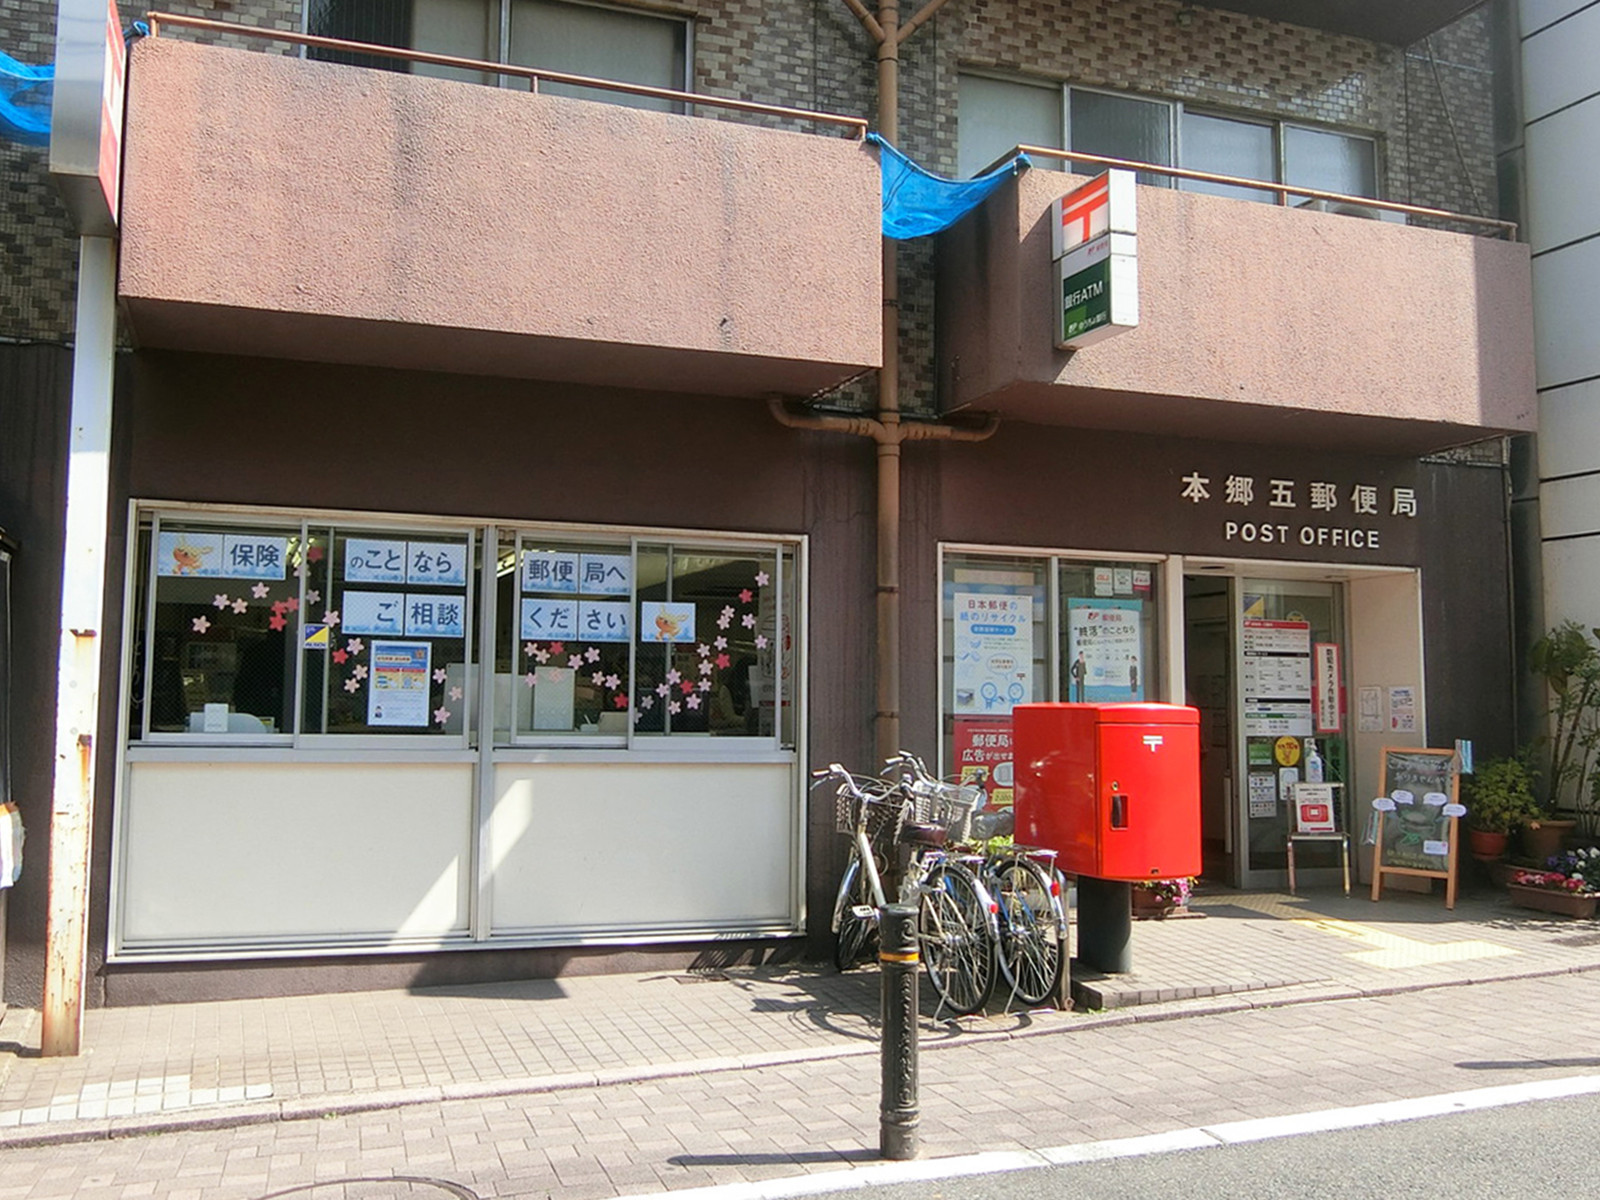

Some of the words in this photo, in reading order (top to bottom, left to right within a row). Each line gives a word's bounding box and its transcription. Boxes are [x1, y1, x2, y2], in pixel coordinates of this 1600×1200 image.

[1064, 280, 1103, 310] 銀行ATM
[1181, 471, 1417, 517] 本郷五郵便局
[1225, 521, 1289, 543] POST
[1300, 526, 1379, 548] OFFICE
[230, 543, 279, 569] 保険
[350, 549, 452, 573] のことなら
[528, 559, 626, 584] 郵便局へ
[377, 601, 459, 626] ご相談
[968, 599, 1017, 610] 日本郵便の
[530, 606, 626, 630] ください
[972, 733, 1013, 748] 郵便局
